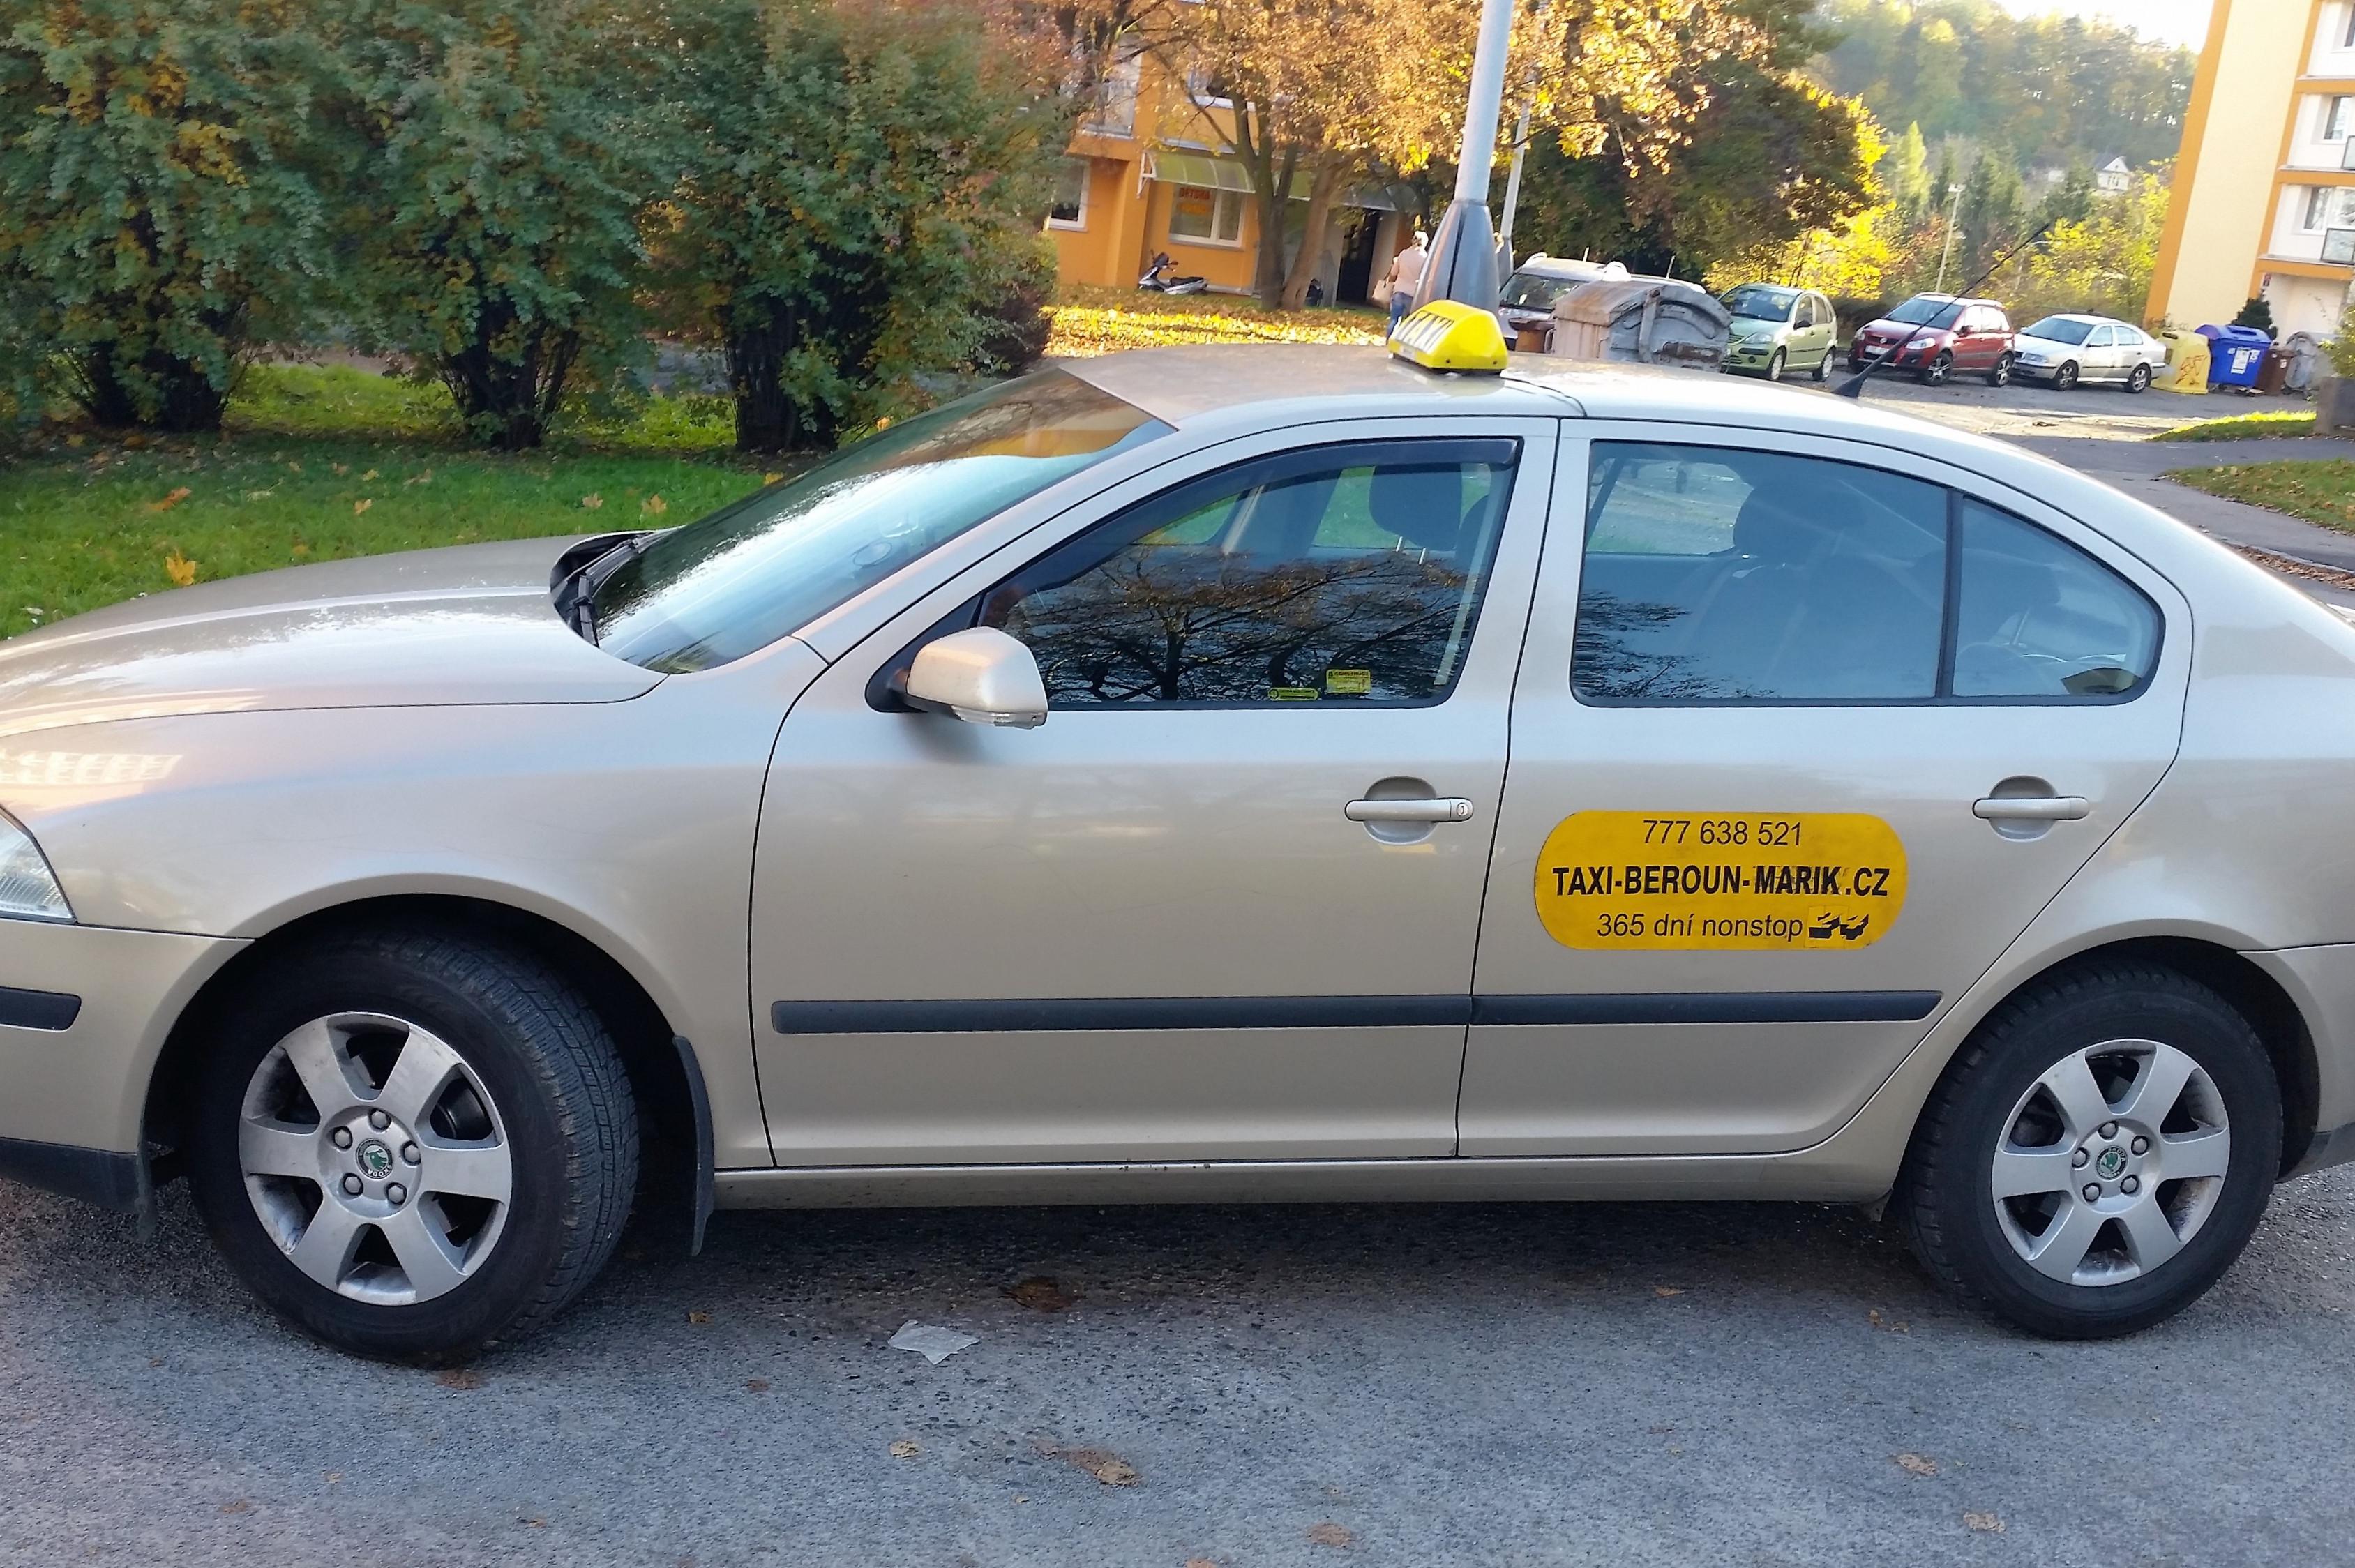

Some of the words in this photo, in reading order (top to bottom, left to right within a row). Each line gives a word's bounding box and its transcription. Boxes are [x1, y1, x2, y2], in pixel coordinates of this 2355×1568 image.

[1395, 310, 1454, 352] TAXI
[1643, 820, 1691, 844] 777
[1700, 820, 1748, 845] 638
[1757, 821, 1801, 846] 521
[1552, 864, 1890, 896] TAXI-BEROUN-MARIK.CZ
[1597, 912, 1645, 937] 365
[1653, 913, 1694, 937] dní
[1701, 914, 1803, 942] nonstop
